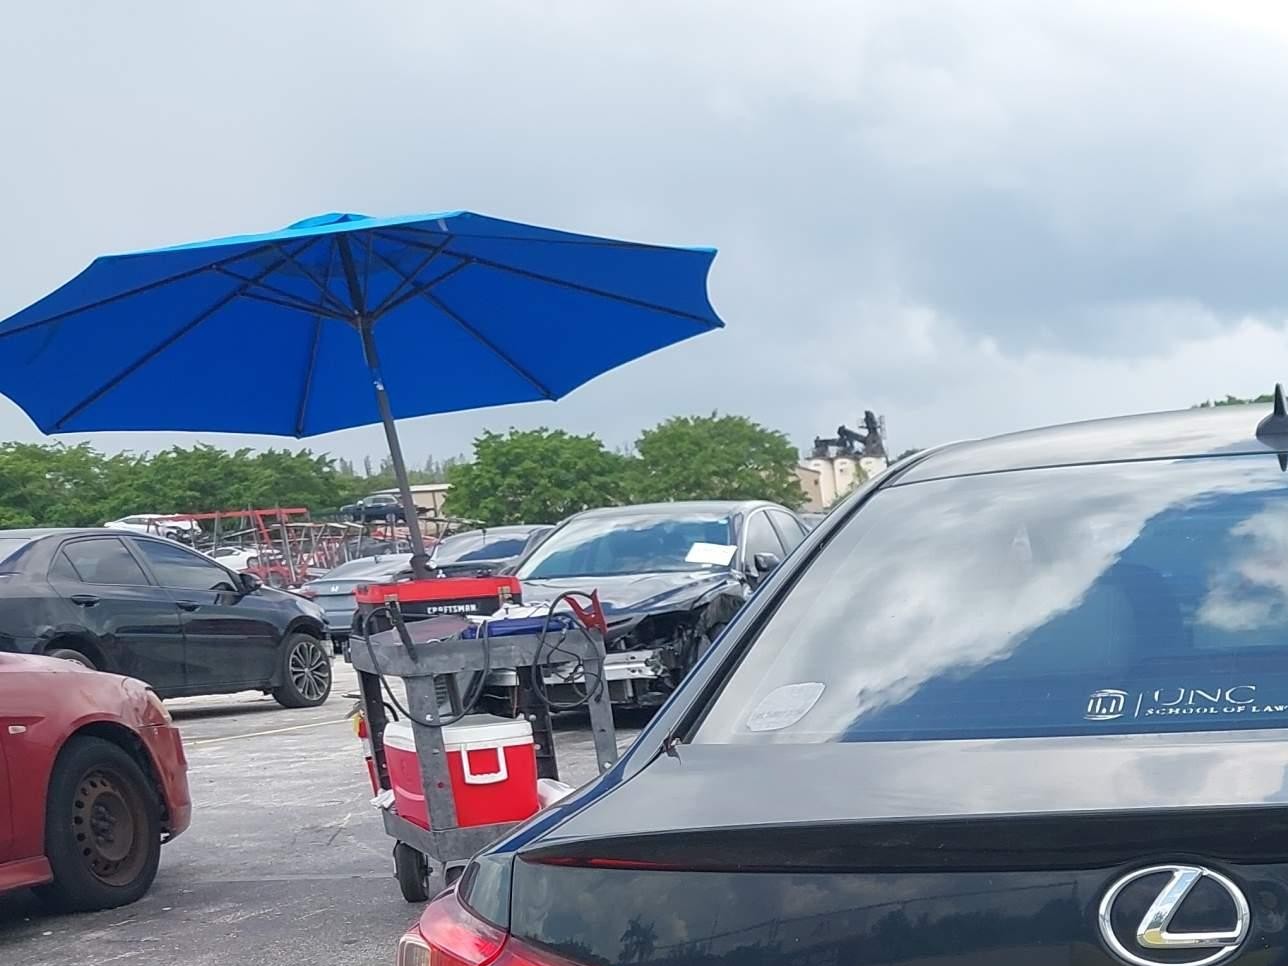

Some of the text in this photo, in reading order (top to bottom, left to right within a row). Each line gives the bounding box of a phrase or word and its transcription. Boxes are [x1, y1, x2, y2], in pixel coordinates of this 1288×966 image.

[1154, 685, 1256, 705] UNC
[1145, 705, 1288, 716] SCHOOL OF LAW
